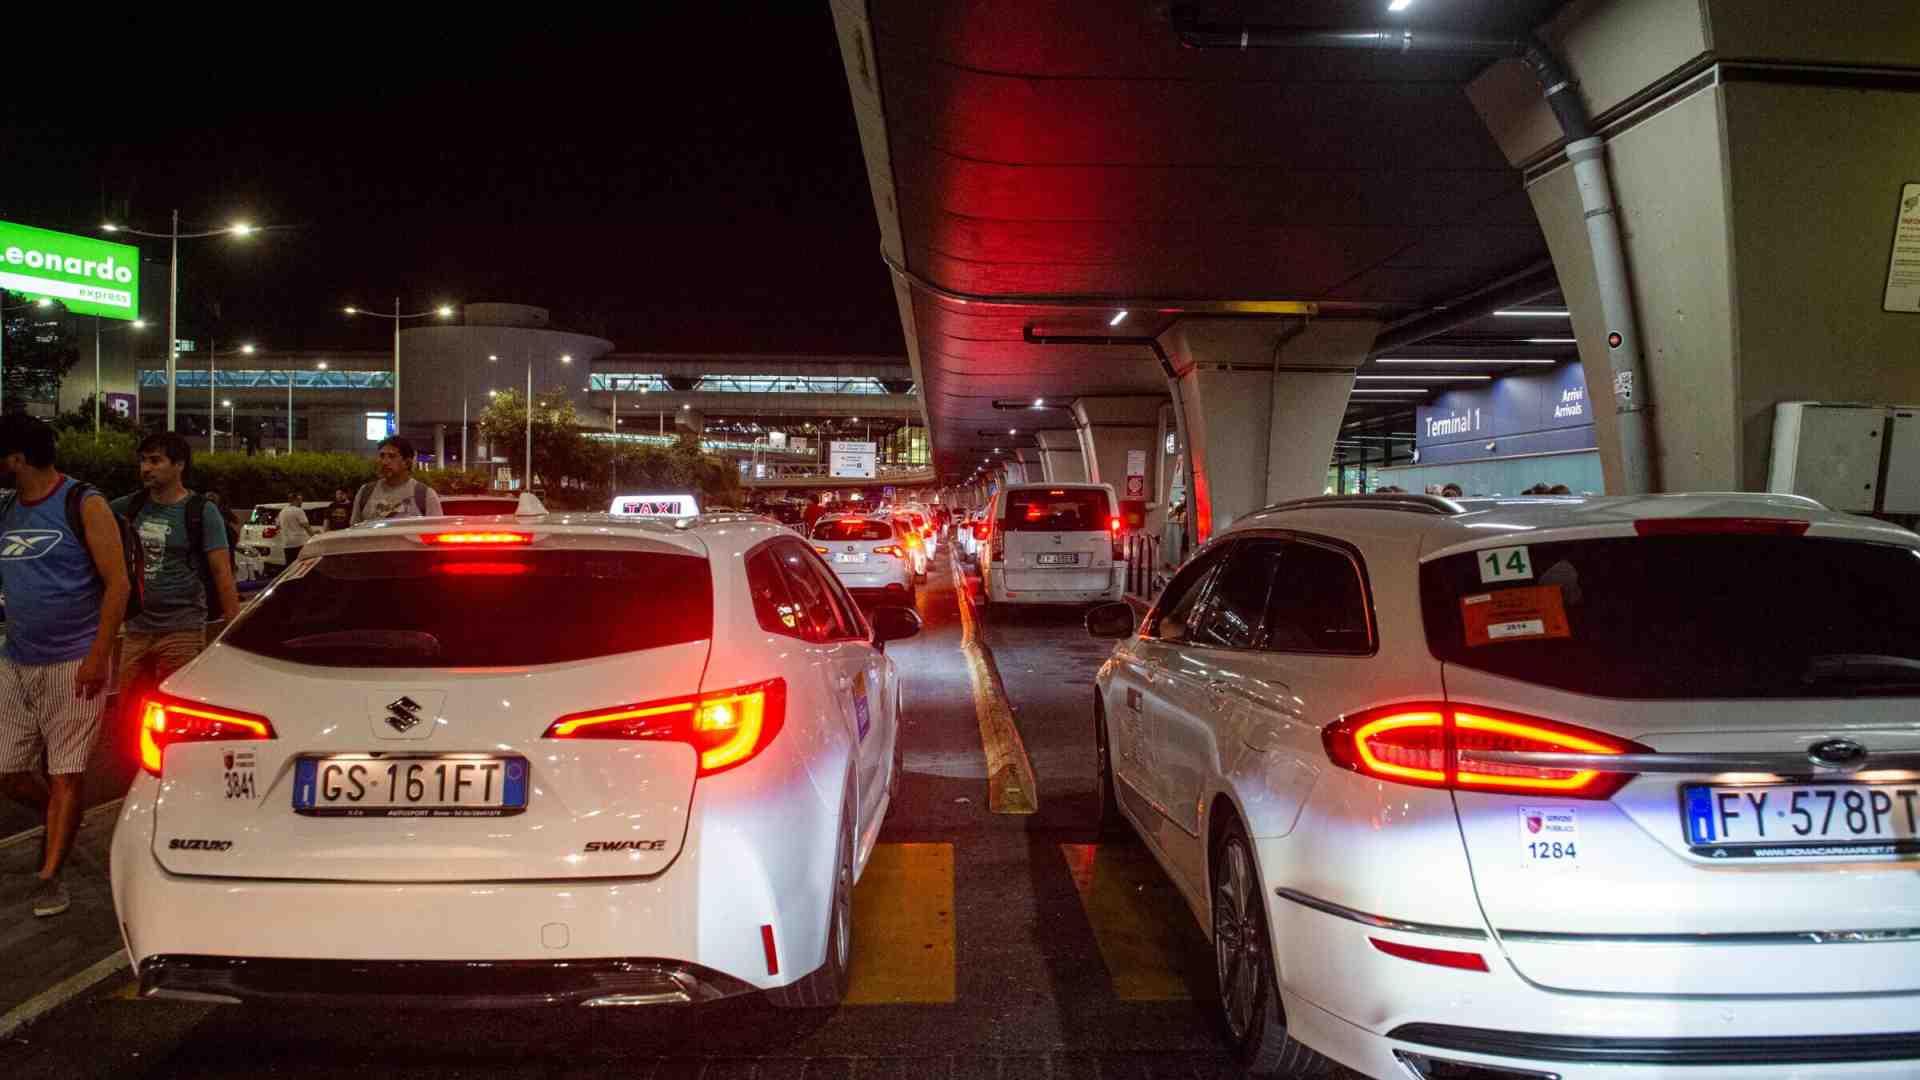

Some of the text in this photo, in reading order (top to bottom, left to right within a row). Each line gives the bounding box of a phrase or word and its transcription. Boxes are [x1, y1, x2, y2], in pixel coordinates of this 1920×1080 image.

[0, 246, 132, 283] eonardo
[79, 287, 127, 303] express
[1561, 386, 1584, 401] Arrivi
[115, 399, 129, 419] B
[1553, 403, 1583, 418] Arrivals
[1425, 407, 1481, 437] Terminal 1
[624, 501, 680, 514] TAXI
[1485, 550, 1526, 576] 14
[224, 771, 256, 800] 3841
[584, 839, 666, 852] SWACE
[1529, 841, 1577, 859] 1284
